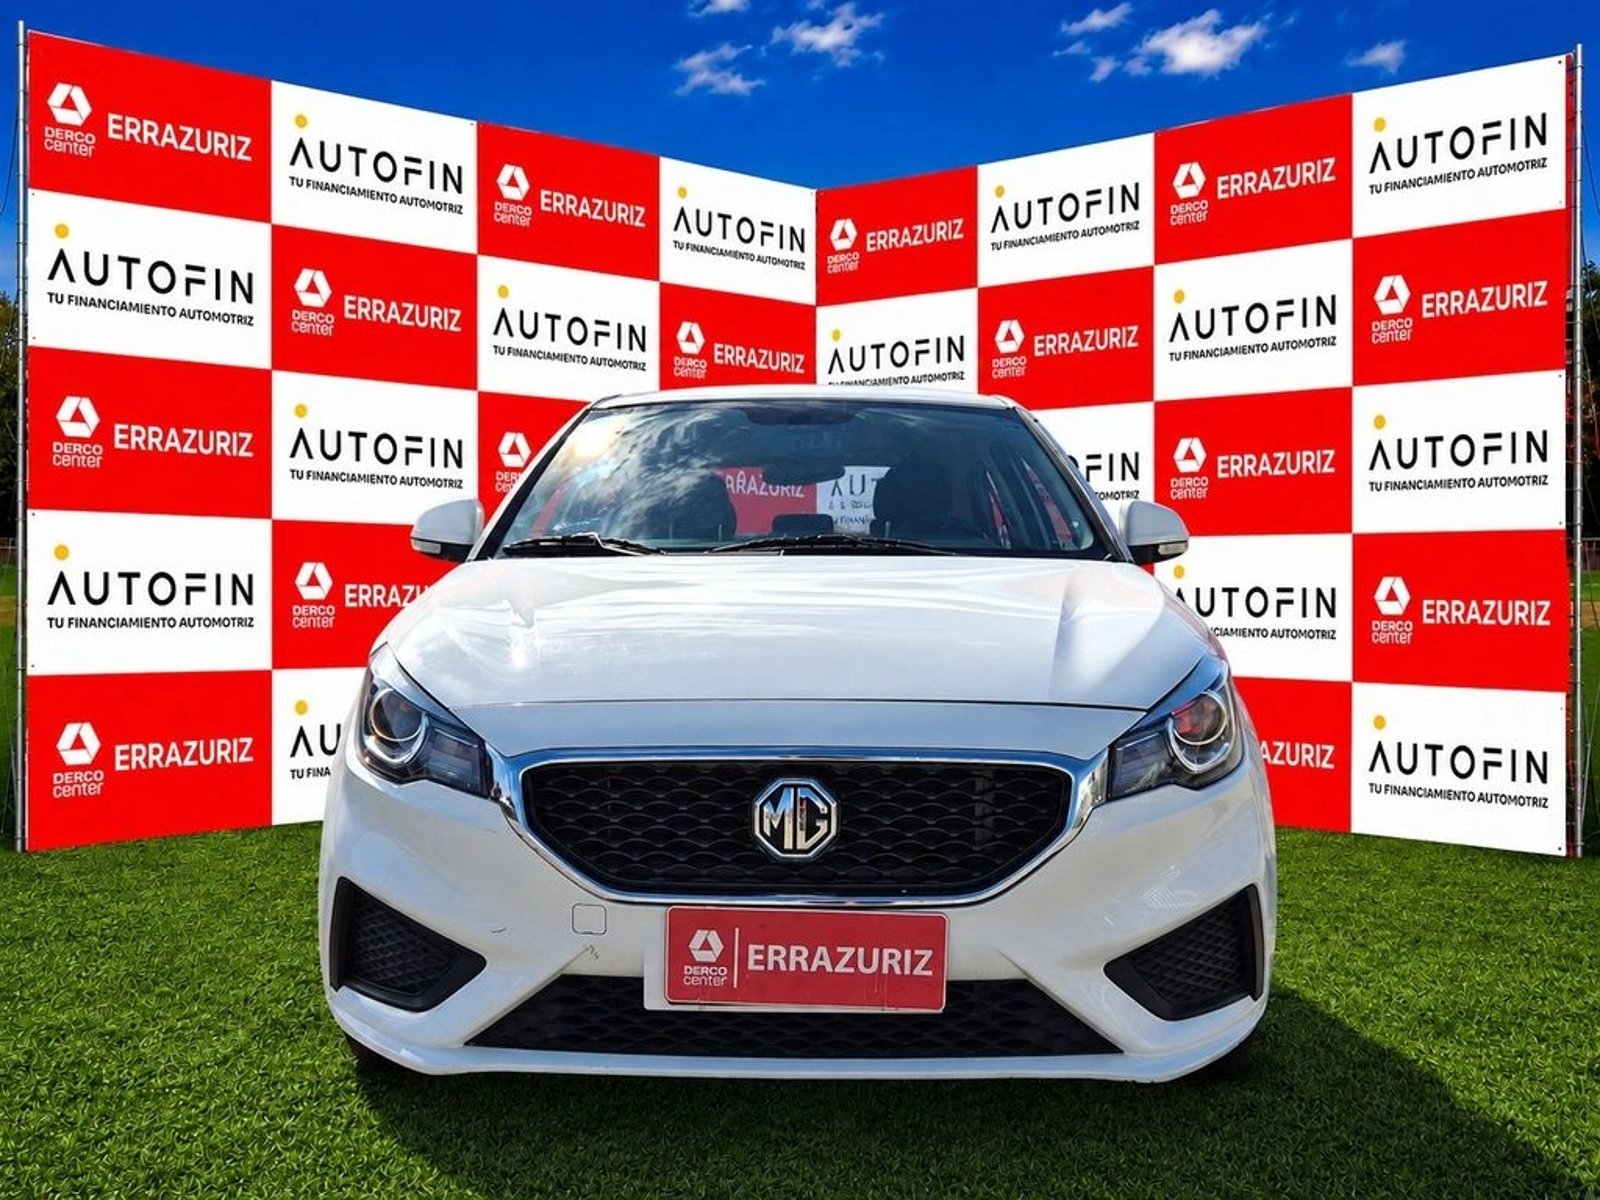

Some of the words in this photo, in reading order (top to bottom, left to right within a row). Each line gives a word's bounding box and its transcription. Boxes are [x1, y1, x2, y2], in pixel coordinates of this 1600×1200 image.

[44, 125, 96, 145] DERCO
[44, 138, 95, 157] center
[107, 112, 252, 161] ERRAZURIZ
[1368, 111, 1547, 174] AUTOFIN
[289, 136, 463, 195] AUTOFIN
[1216, 156, 1336, 199] ERRAZURIZ
[1368, 183, 1382, 195] TU
[1383, 167, 1476, 193] FINANCIAMIENTO
[1476, 156, 1548, 178] AUTOMOTRIZ
[288, 175, 304, 188] TU
[305, 178, 398, 204] FINANCIAMIENTO
[399, 194, 463, 215] AUTOMOTRIZ
[494, 201, 532, 216] DERCO
[540, 189, 645, 227] ERRAZURIZ
[990, 181, 1140, 234] AUTOFIN
[1170, 199, 1209, 215] DERCO
[672, 206, 806, 254] AUTOFIN
[1170, 210, 1208, 226] center
[866, 217, 964, 252] ERRAZURIZ
[990, 241, 1002, 251] TU
[1002, 229, 1080, 249] FINANCIAMIENTO
[1080, 219, 1140, 238] AUTOMOTRIZ
[672, 239, 685, 251] TU
[685, 241, 755, 262] FINANCIAMIENTO
[755, 254, 806, 271] AUTOMOTRIZ
[827, 251, 860, 265] DERCO
[46, 247, 253, 305] AUTOFIN
[46, 291, 64, 305] TU
[67, 293, 177, 318] FINANCIAMIENTO
[178, 307, 254, 327] AUTOMOTRIZ
[1421, 280, 1548, 318] ERRAZURIZ
[291, 309, 335, 325] DERCO
[343, 294, 461, 332] ERRAZURIZ
[1168, 293, 1336, 343] AUTOFIN
[1371, 317, 1413, 332] DERCO
[291, 320, 334, 336] center
[492, 306, 646, 353] AUTOFIN
[1033, 324, 1138, 357] ERRAZURIZ
[1371, 328, 1412, 344] center
[492, 344, 506, 356] TU
[506, 345, 588, 365] FINANCIAMIENTO
[589, 355, 646, 372] AUTOMOTRIZ
[713, 342, 806, 374] ERRAZURIZ
[828, 335, 964, 375] AUTOFIN
[991, 355, 1027, 368] DERCO
[1168, 351, 1182, 362] TU
[1182, 342, 1269, 360] FINANCIAMIENTO
[1269, 335, 1337, 352] AUTOMOTRIZ
[673, 355, 707, 370] DERCO
[910, 371, 965, 384] AUTOMOTRIZ
[52, 441, 103, 456] DERCO
[113, 423, 253, 457] ERRAZURIZ
[289, 427, 463, 469] AUTOFIN
[1368, 429, 1548, 471] AUTOFIN
[52, 453, 102, 468] center
[1217, 448, 1335, 478] ERRAZURIZ
[289, 468, 304, 481] TU
[305, 469, 398, 486] FINANCIAMIENTO
[399, 475, 463, 490] AUTOMOTRIZ
[1170, 476, 1209, 488] DERCO
[1170, 486, 1208, 499] center
[1368, 480, 1383, 492] TU
[1384, 477, 1476, 491] FINANCIAMIENTO
[1476, 474, 1549, 488] AUTOMOTRIZ
[47, 570, 254, 606] AUTOFIN
[46, 616, 64, 629] TU
[67, 616, 177, 629] FINANCIAMIENTO
[178, 616, 254, 628] AUTOMOTRIZ
[292, 605, 335, 616] DERCO
[292, 616, 335, 628] center
[1422, 599, 1551, 626] ERRAZURIZ
[1270, 628, 1337, 640] AUTOMOTRIZ
[1371, 620, 1413, 632] DERCO
[1371, 630, 1412, 644] center
[114, 736, 254, 771] ERRAZURIZ
[1368, 740, 1548, 785] AUTOFIN
[52, 769, 104, 785] DERCO
[289, 768, 304, 780] TU
[52, 782, 104, 798] center
[1368, 781, 1382, 794] TU
[1383, 783, 1476, 803] FINANCIAMIENTO
[1476, 791, 1549, 809] AUTOMOTRIZ
[762, 787, 829, 850] MG
[683, 965, 727, 977] DERCO
[747, 944, 933, 977] ERRAZURIZ
[683, 975, 727, 988] center
